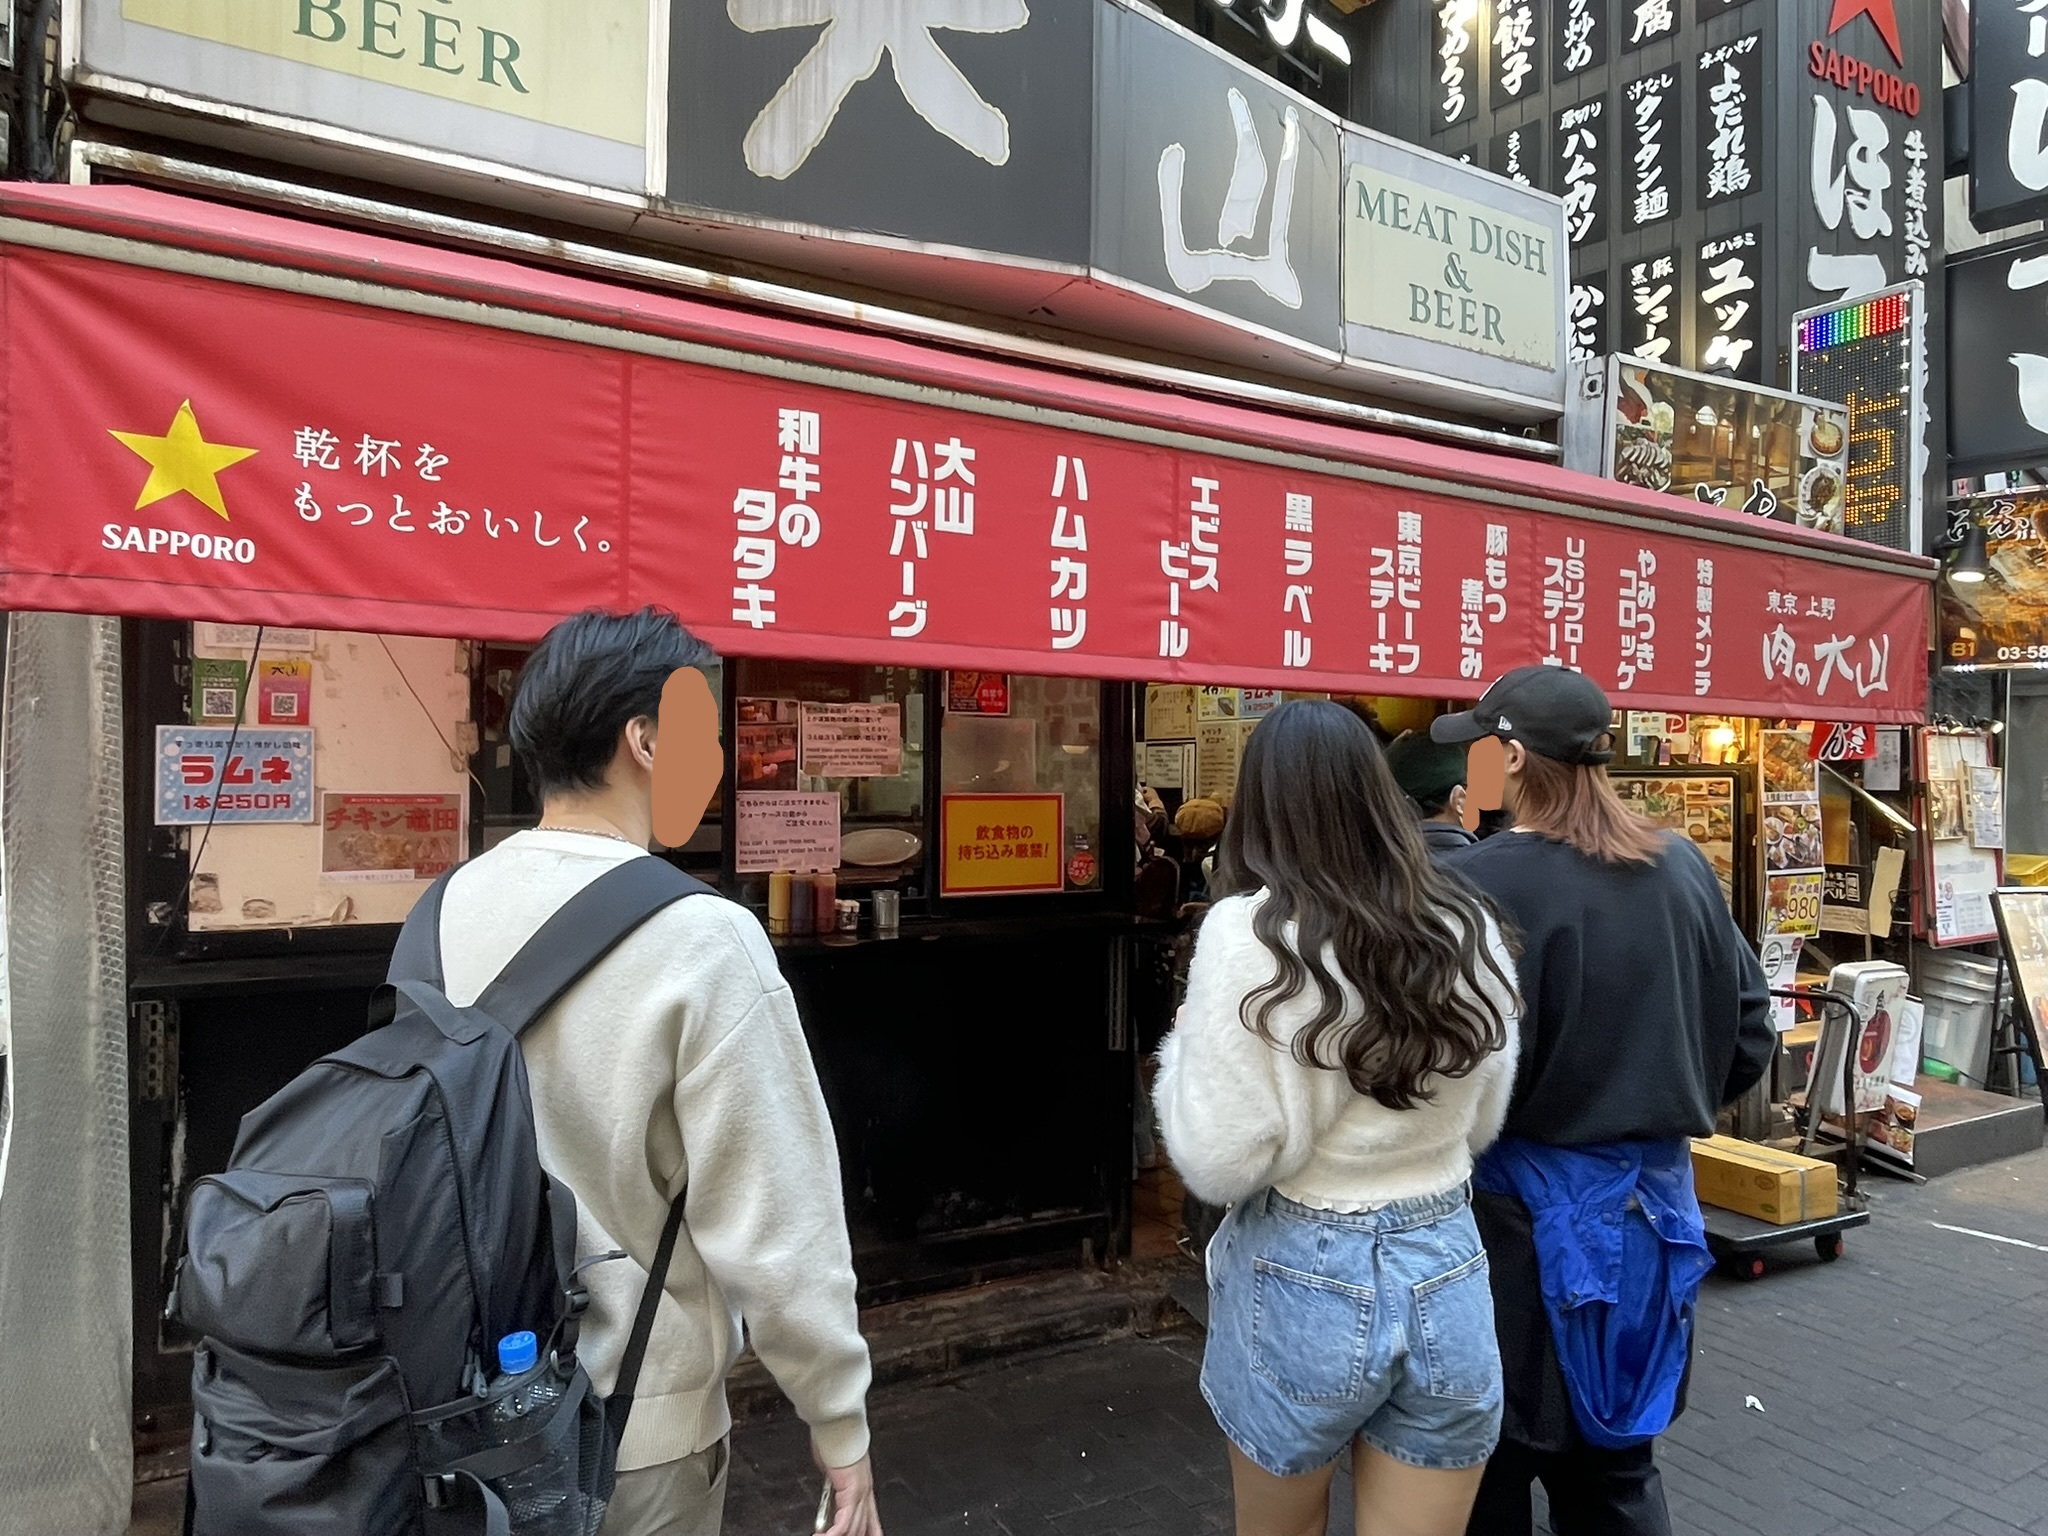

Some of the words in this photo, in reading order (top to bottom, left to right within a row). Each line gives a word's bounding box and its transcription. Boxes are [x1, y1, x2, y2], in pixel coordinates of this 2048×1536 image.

[292, 0, 530, 93] BEER
[1627, 74, 1673, 100] 汁なし
[1809, 40, 1921, 116] SAPPORO
[1633, 95, 1669, 224] タンタン麺
[1706, 62, 1751, 198] よだれ鶏
[1356, 180, 1457, 245] MEAT
[1468, 216, 1547, 275] DISH
[1563, 129, 1597, 242] ハムカツ
[1904, 130, 1930, 276] 牛煮込み
[1444, 252, 1473, 293] &
[1701, 233, 1756, 260] 豚ハラミ
[1409, 283, 1506, 346] BEER
[293, 426, 449, 482] 乾杯を
[778, 408, 821, 548] 和牛の
[934, 437, 976, 535] 大山
[102, 523, 256, 564] SAPPORO
[294, 484, 611, 553] もっとおいしく。
[732, 487, 776, 629] タタキ
[888, 438, 929, 638] ハンバーグ
[1050, 455, 1088, 650] ハムカツ
[1190, 476, 1220, 593] エビス
[1159, 539, 1190, 658] ビール
[1283, 492, 1313, 668] 黒ラベル
[1369, 547, 1395, 673] ステーキ
[1397, 510, 1422, 674] 東京ビーフ
[1485, 523, 1508, 623] 豚もつ
[1637, 548, 1657, 671] やみつき
[1765, 589, 1798, 615] 東京
[1805, 595, 1836, 621] 上野
[1460, 578, 1484, 679] 煮込み
[1616, 568, 1637, 690] コロッケ
[1762, 622, 1890, 698] 肉の大山
[1951, 642, 1975, 657] B1
[181, 755, 292, 785] ラムネ
[182, 793, 291, 810] 1本250円
[976, 825, 1034, 840] 飲食物の
[1787, 896, 1819, 920] 980
